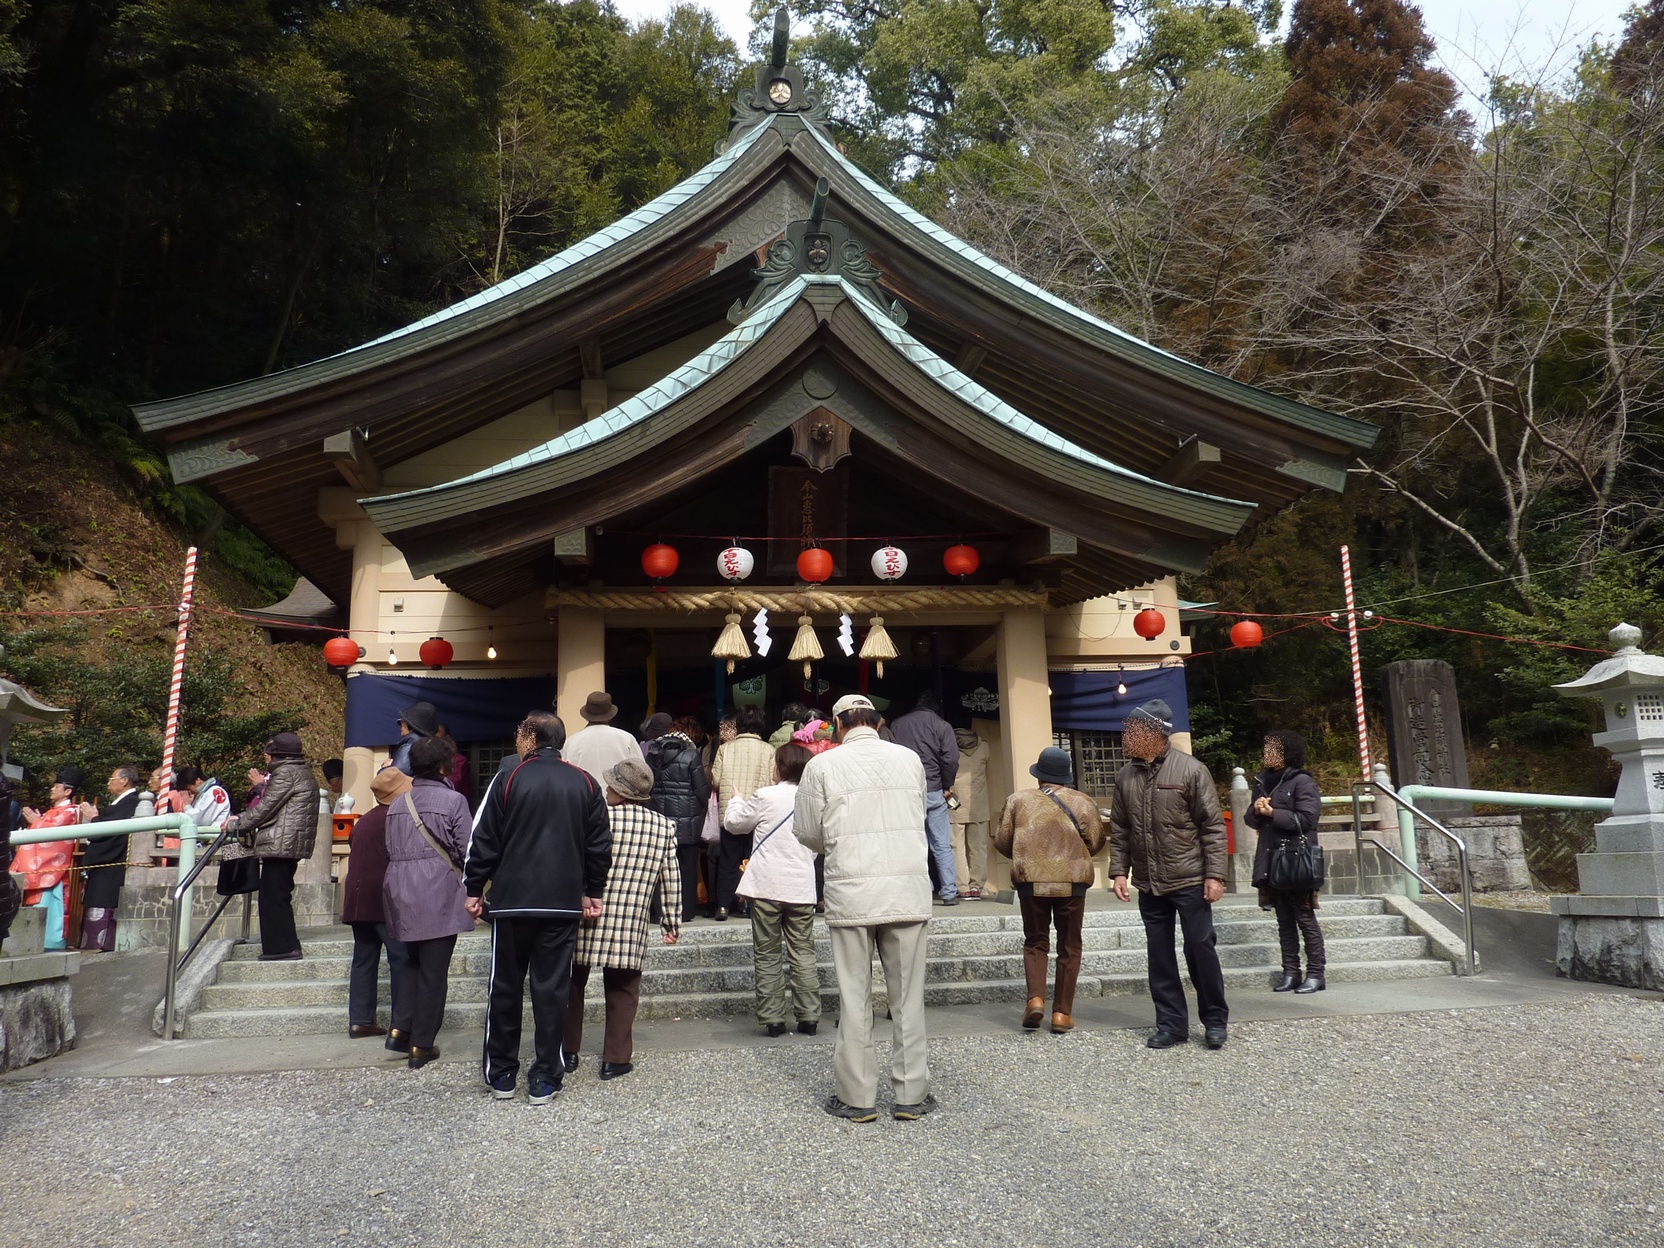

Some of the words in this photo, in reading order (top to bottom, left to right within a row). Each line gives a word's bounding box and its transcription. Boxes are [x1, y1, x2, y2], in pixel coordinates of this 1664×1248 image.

[1409, 697, 1435, 786] 御造営記念
